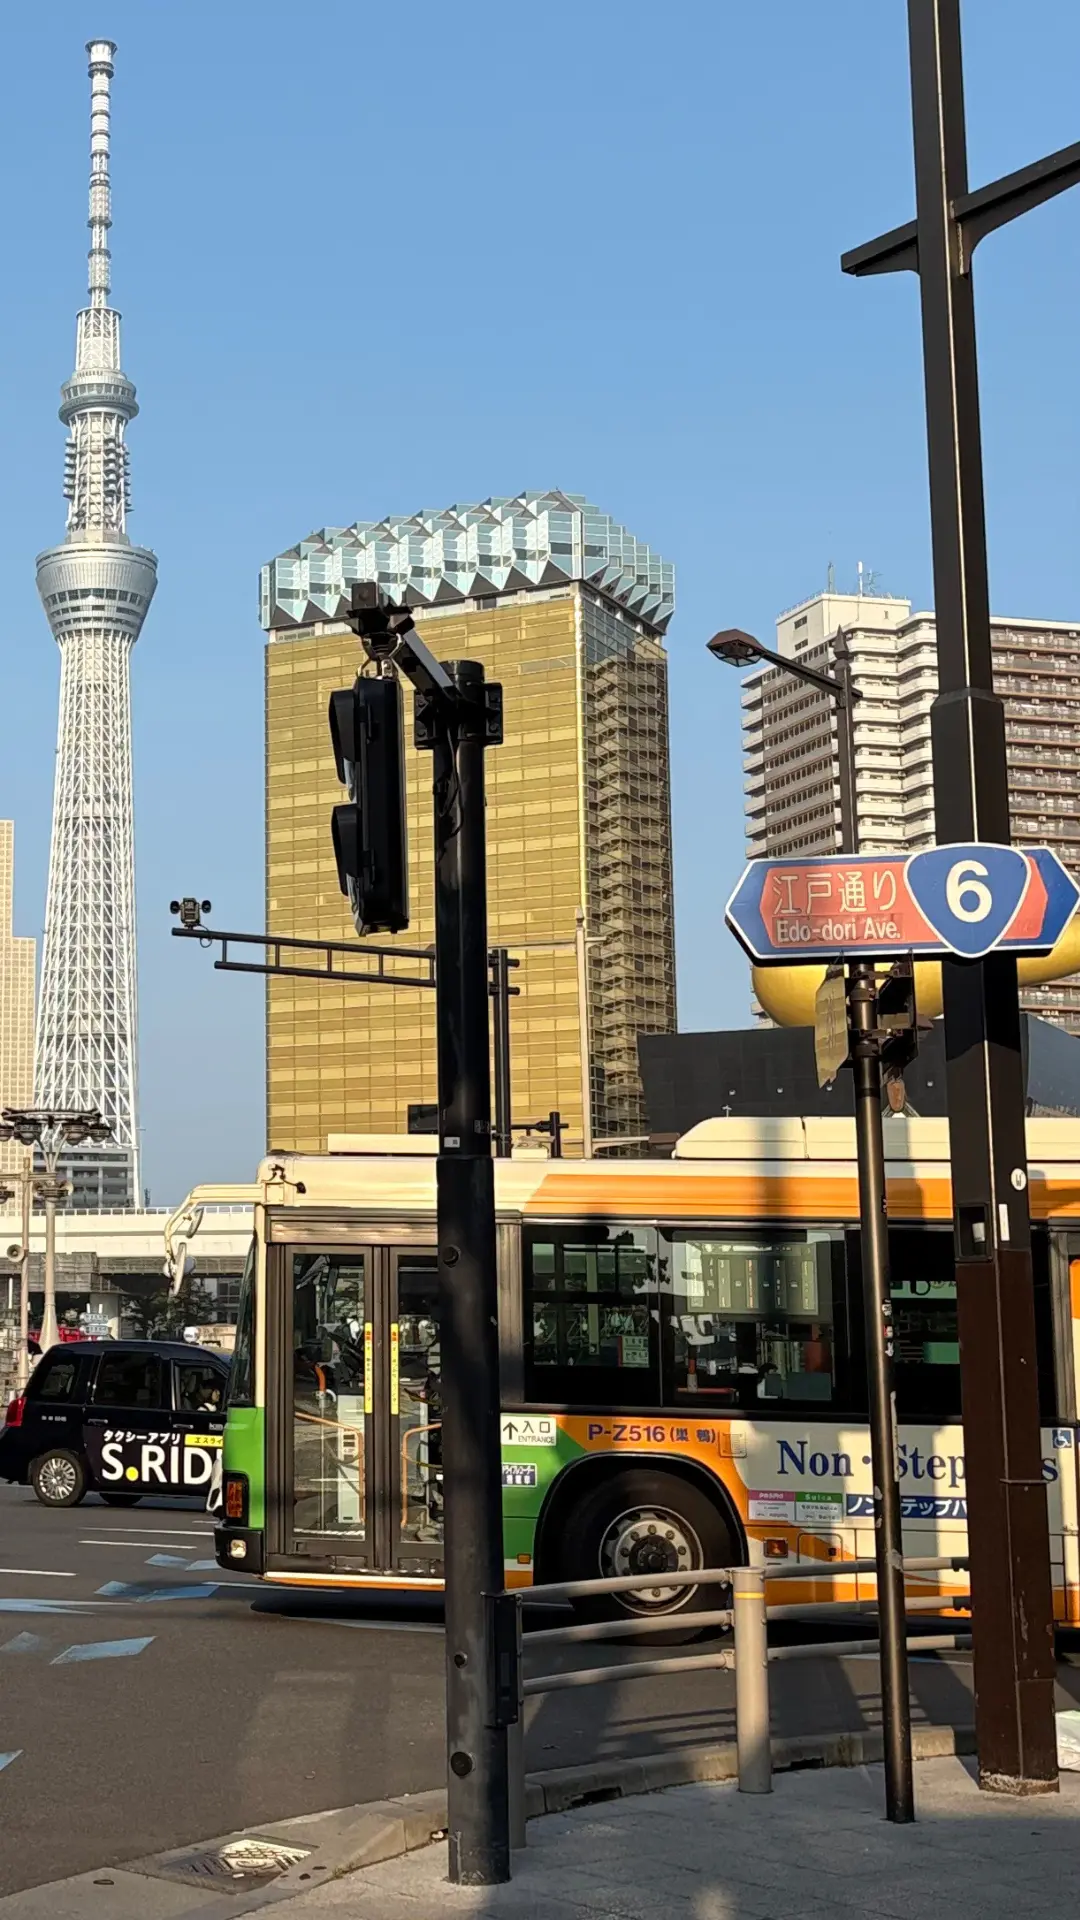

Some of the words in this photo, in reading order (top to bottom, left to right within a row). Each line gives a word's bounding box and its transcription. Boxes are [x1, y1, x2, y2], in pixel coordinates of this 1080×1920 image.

[772, 869, 898, 915] 江戸通り
[945, 860, 993, 923] 6
[776, 917, 857, 943] Edo-dori
[864, 917, 902, 939] Ave.
[103, 1429, 181, 1445] タクシーアプリ
[522, 1420, 551, 1434] 入口
[588, 1424, 665, 1442] P-Z516
[518, 1435, 555, 1444] ENTRANCE
[101, 1443, 223, 1486] S.RID
